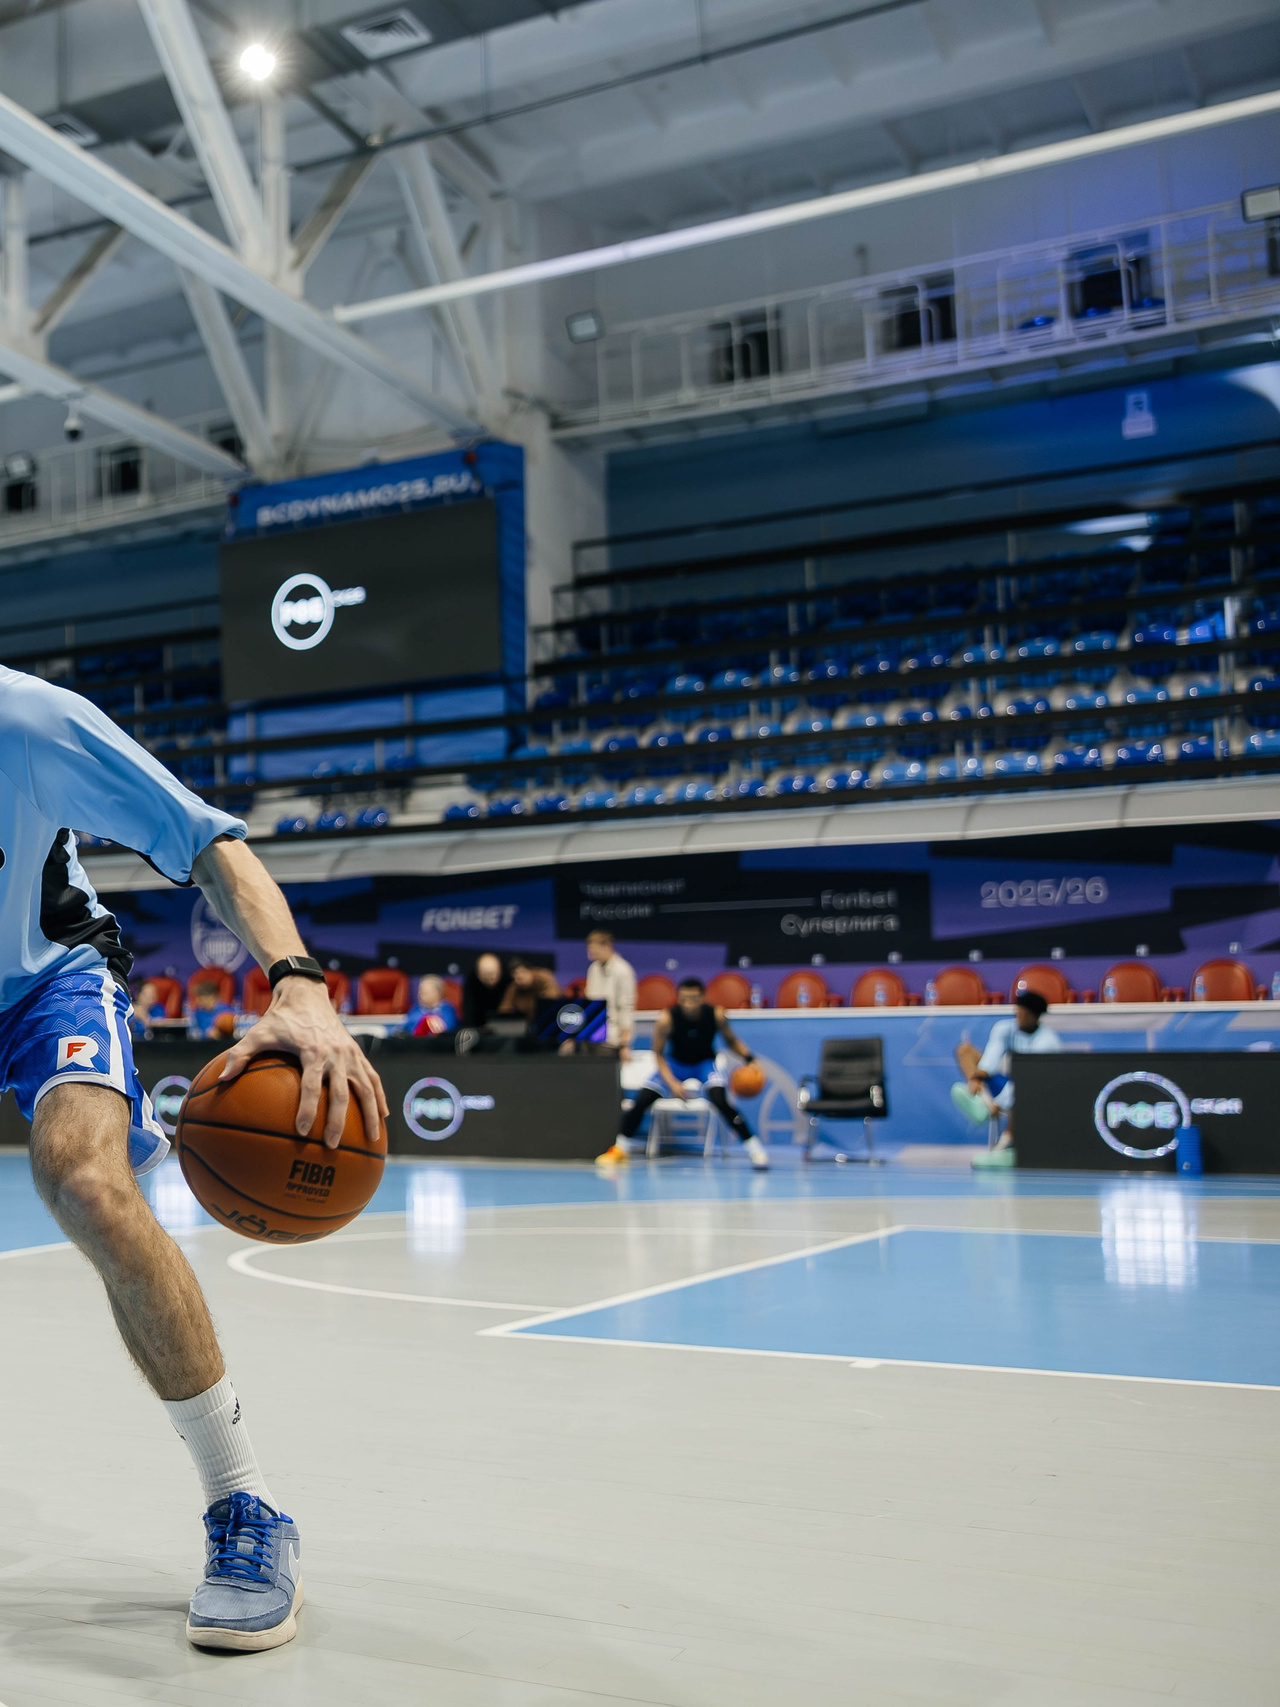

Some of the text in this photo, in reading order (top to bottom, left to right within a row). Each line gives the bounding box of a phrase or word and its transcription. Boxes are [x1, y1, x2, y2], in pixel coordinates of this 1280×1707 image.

[980, 876, 1108, 908] 2025/26
[421, 904, 518, 932] FONBET
[288, 1159, 336, 1187] FIBA
[211, 1202, 334, 1242] JÖGE
